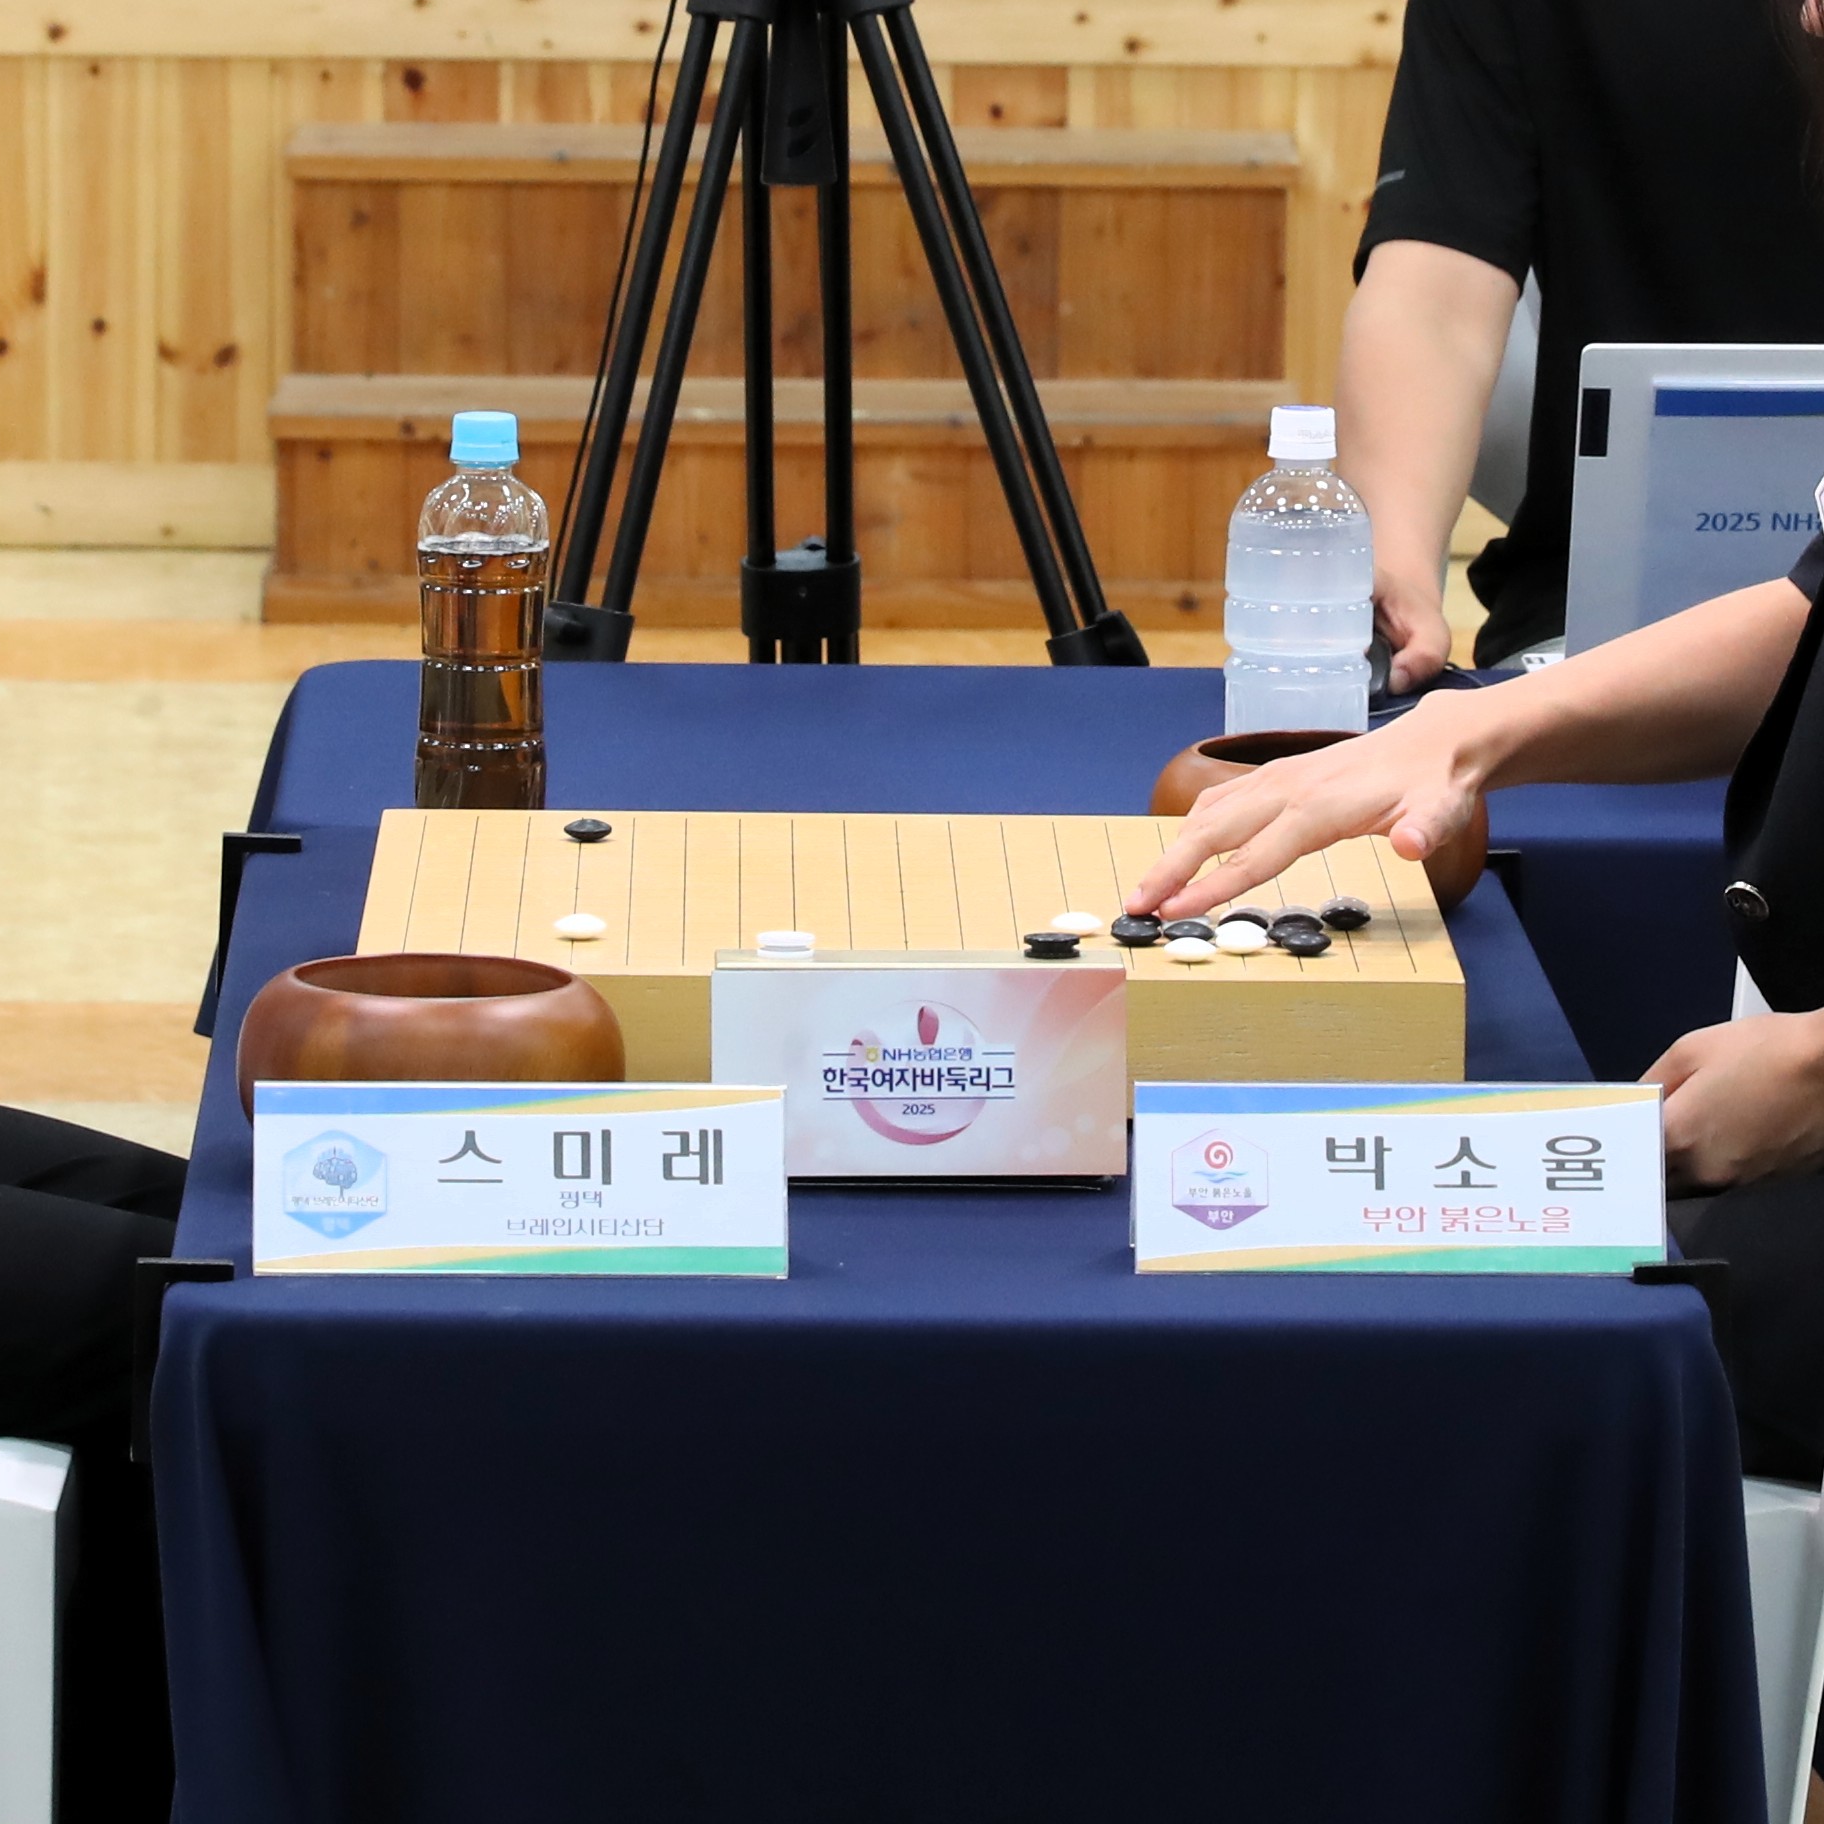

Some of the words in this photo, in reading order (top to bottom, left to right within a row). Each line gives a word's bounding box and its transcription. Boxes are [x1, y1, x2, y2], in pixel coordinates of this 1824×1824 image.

[1695, 512, 1761, 533] 2025
[1771, 510, 1822, 533] NH
[881, 1047, 973, 1062] NH농협은행
[822, 1066, 1016, 1094] 한국여자바둑리그
[901, 1103, 936, 1116] 2025
[1188, 1186, 1209, 1199] 부안
[1206, 1208, 1236, 1225] 부안
[1363, 1206, 1427, 1233] 부안
[1440, 1205, 1570, 1233] 붉은노을
[506, 1217, 664, 1237] 브레인시티산단
